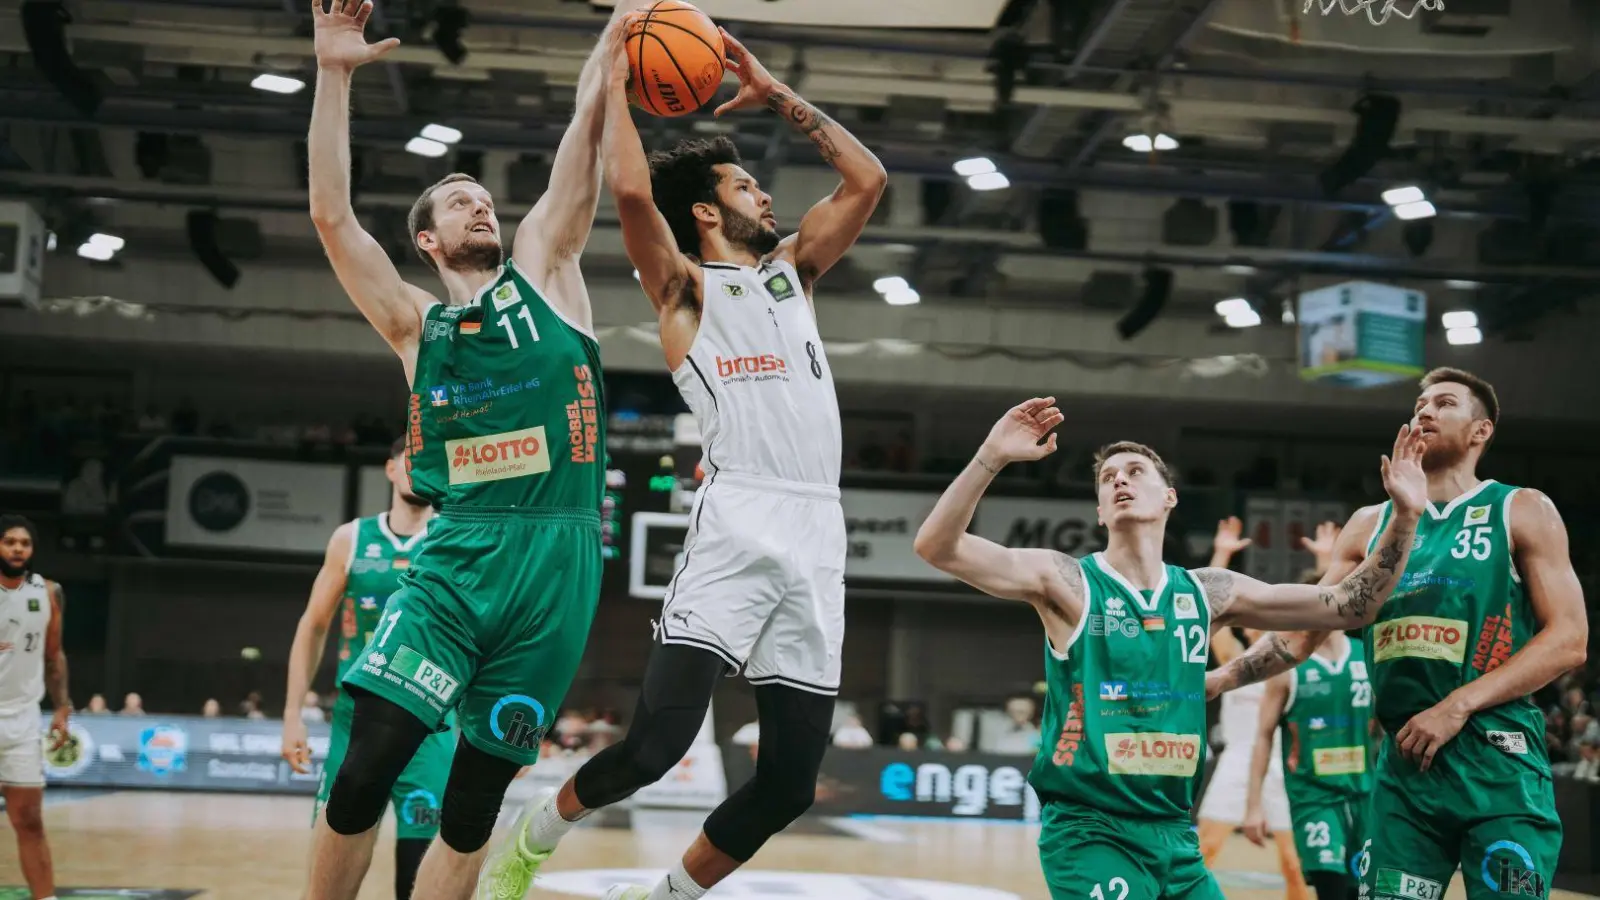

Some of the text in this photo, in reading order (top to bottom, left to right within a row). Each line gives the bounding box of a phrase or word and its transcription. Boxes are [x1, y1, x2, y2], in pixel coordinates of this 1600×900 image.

[497, 304, 540, 349] 11
[715, 354, 787, 378] brose
[806, 341, 822, 380] 8
[472, 436, 540, 464] LOTTO
[1451, 527, 1492, 560] 35
[1088, 614, 1140, 638] EPG
[1396, 624, 1460, 644] LOTTO
[1173, 624, 1207, 663] 12
[420, 665, 452, 695] P&T
[1141, 740, 1195, 760] LOTTO
[1304, 821, 1330, 848] 23
[1359, 838, 1372, 877] 5
[1406, 879, 1438, 900] P&T
